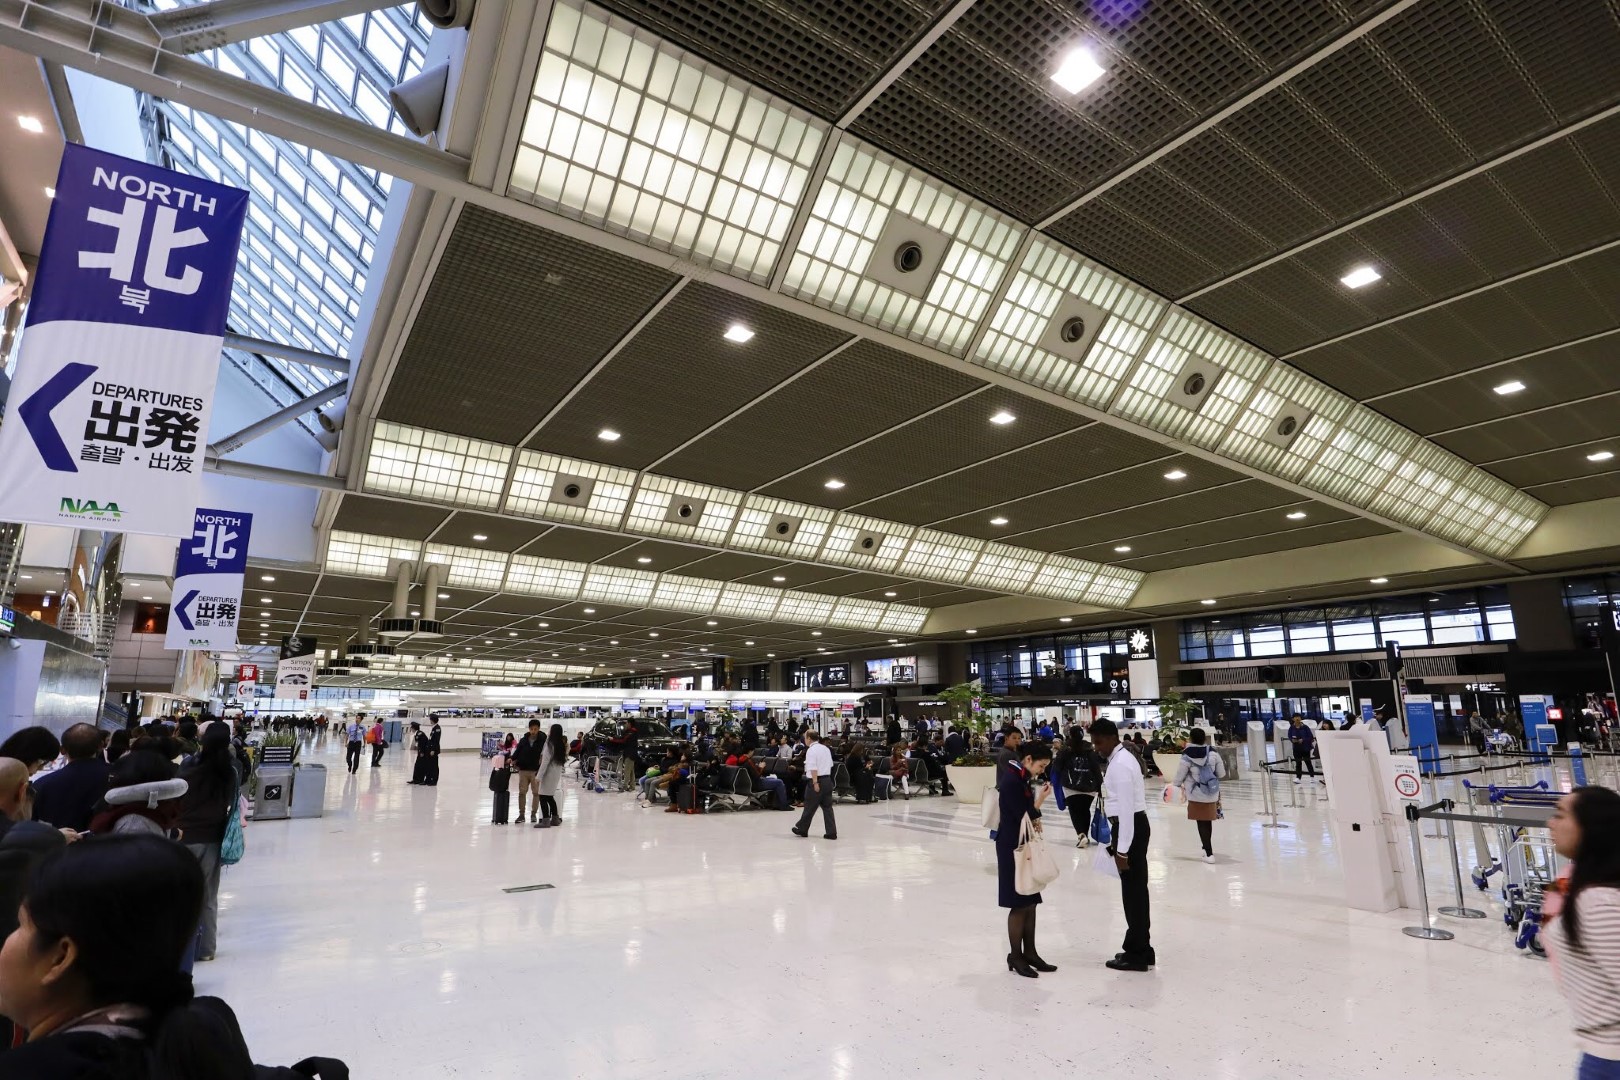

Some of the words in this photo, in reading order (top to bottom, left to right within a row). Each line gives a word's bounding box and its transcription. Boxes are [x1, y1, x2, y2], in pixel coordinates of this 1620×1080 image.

[92, 167, 217, 216] NORTH
[78, 196, 210, 296] 北
[119, 285, 150, 314] 북
[92, 381, 204, 412] DEPARTURES
[83, 399, 200, 455] 出発
[80, 444, 126, 466] 출발
[148, 451, 195, 474] 出发
[60, 497, 124, 516] NAA
[195, 514, 241, 527] NORTH
[191, 524, 239, 560] 北
[197, 595, 238, 604] DEPARTURES
[196, 602, 237, 620] 出発
[970, 663, 979, 674] H
[1472, 684, 1478, 692] F
